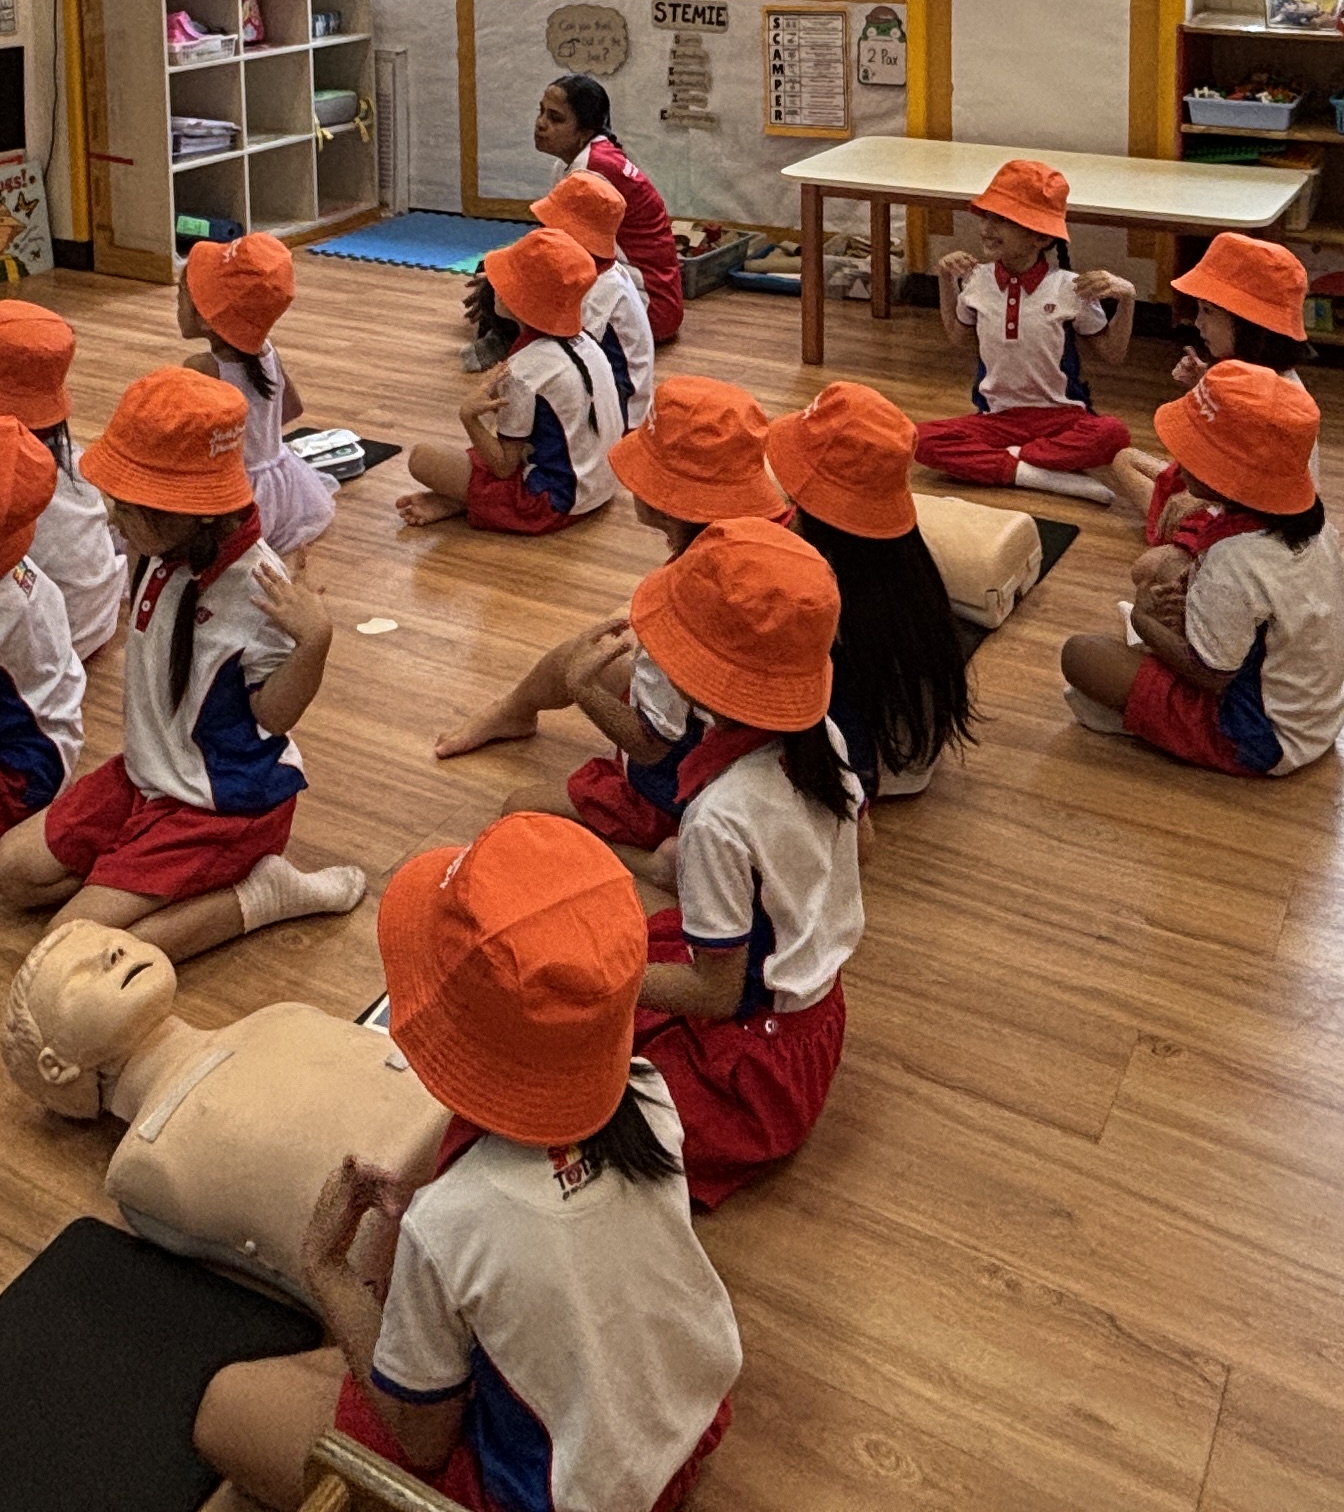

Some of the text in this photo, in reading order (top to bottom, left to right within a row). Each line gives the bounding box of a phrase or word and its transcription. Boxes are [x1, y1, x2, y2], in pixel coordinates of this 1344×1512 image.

[653, 1, 727, 26] STEMIE
[867, 48, 899, 67] 2 Pax
